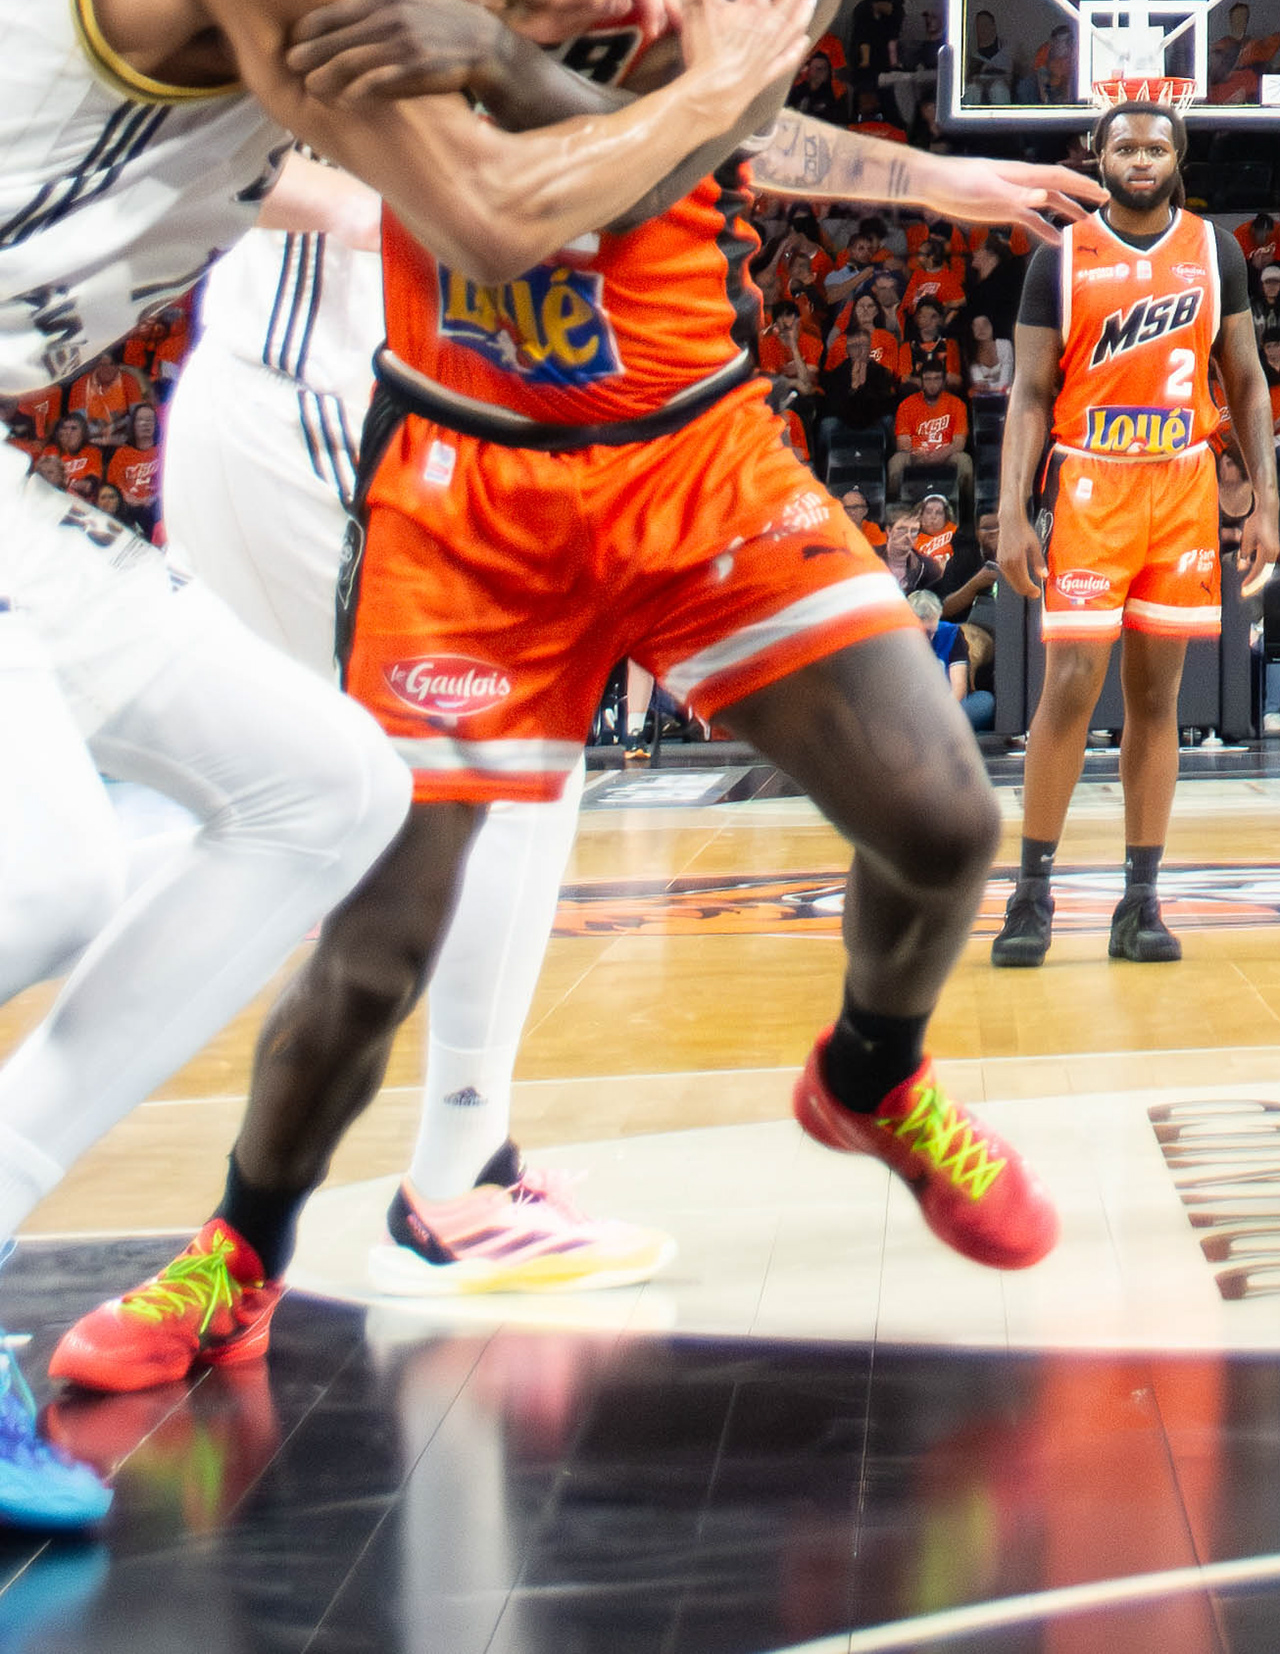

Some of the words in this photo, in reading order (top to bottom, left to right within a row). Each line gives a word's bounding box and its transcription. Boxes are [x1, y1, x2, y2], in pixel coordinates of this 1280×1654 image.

[1089, 288, 1205, 370] MSB
[1167, 348, 1196, 397] 2
[1091, 407, 1188, 453] Loué
[1061, 573, 1110, 592] Gaulois
[405, 661, 512, 702] Gaulois
